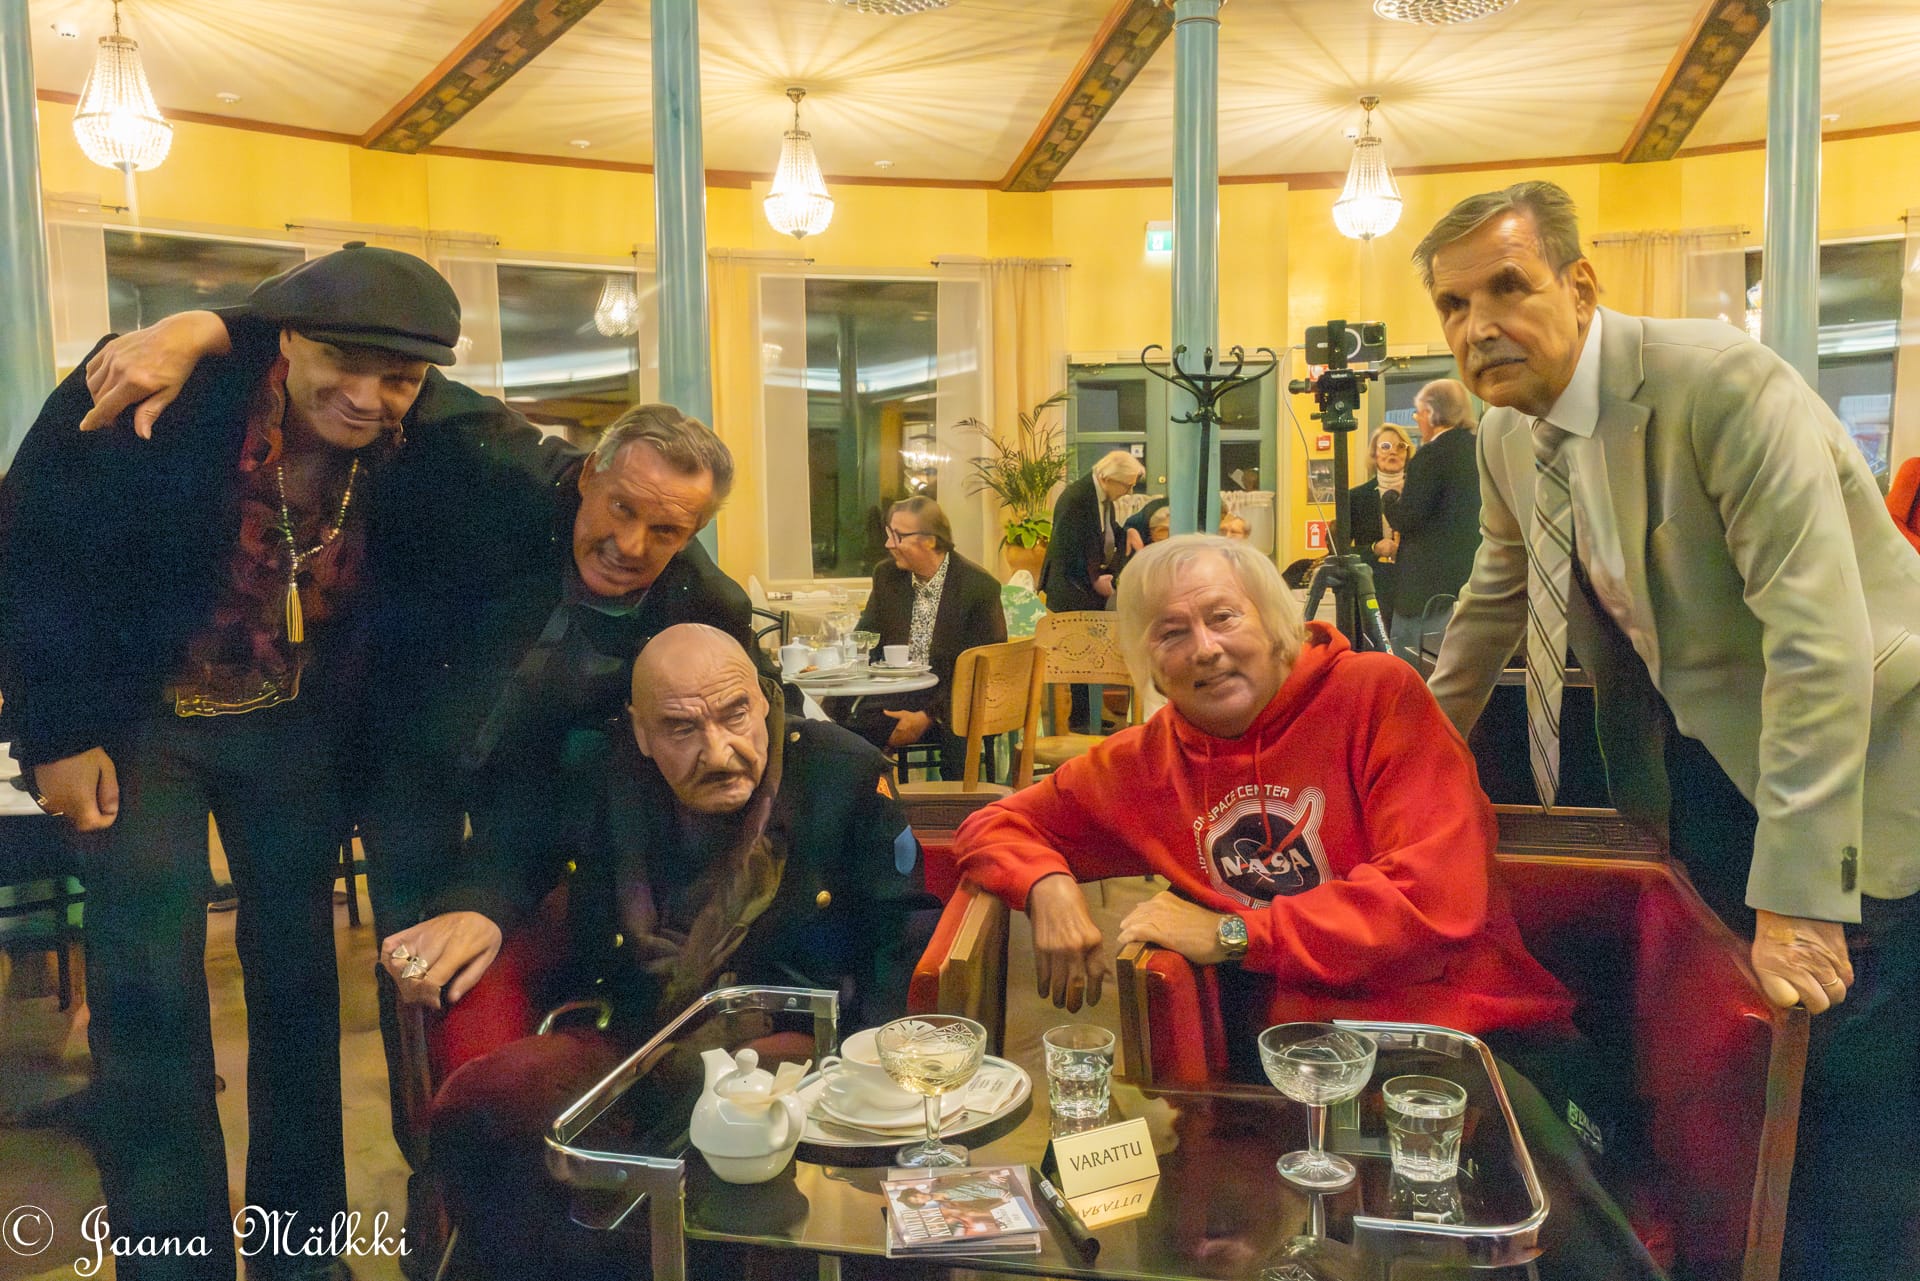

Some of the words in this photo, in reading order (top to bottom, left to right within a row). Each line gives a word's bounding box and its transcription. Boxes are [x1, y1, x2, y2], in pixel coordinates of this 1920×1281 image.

[1207, 790, 1236, 822] SPACE
[1220, 848, 1311, 878] NASA
[1070, 1141, 1142, 1171] VARATTU
